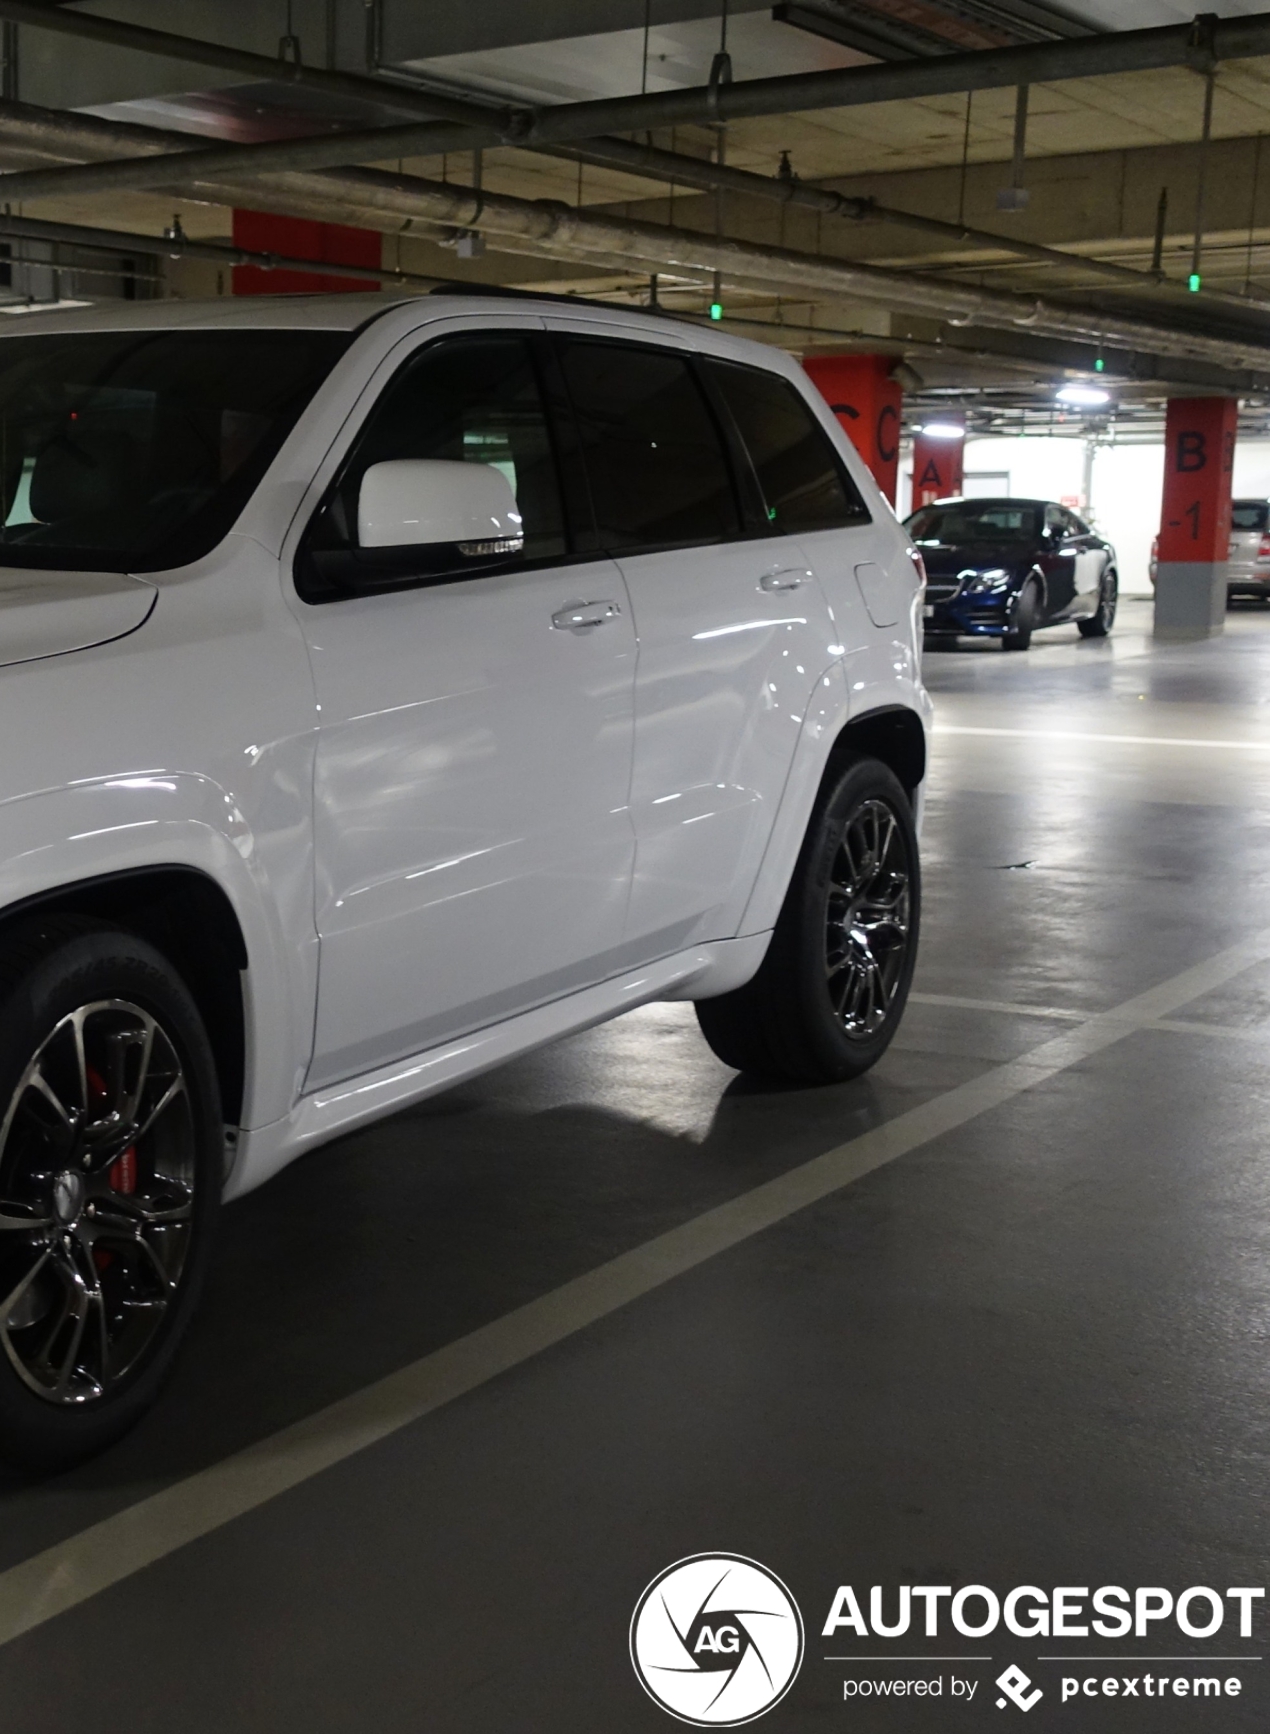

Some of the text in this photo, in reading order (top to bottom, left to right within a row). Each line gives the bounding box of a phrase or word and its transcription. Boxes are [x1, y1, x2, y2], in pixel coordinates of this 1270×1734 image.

[878, 405, 897, 462] C
[1175, 430, 1207, 473] B
[919, 458, 942, 487] A
[1169, 500, 1201, 540] -1
